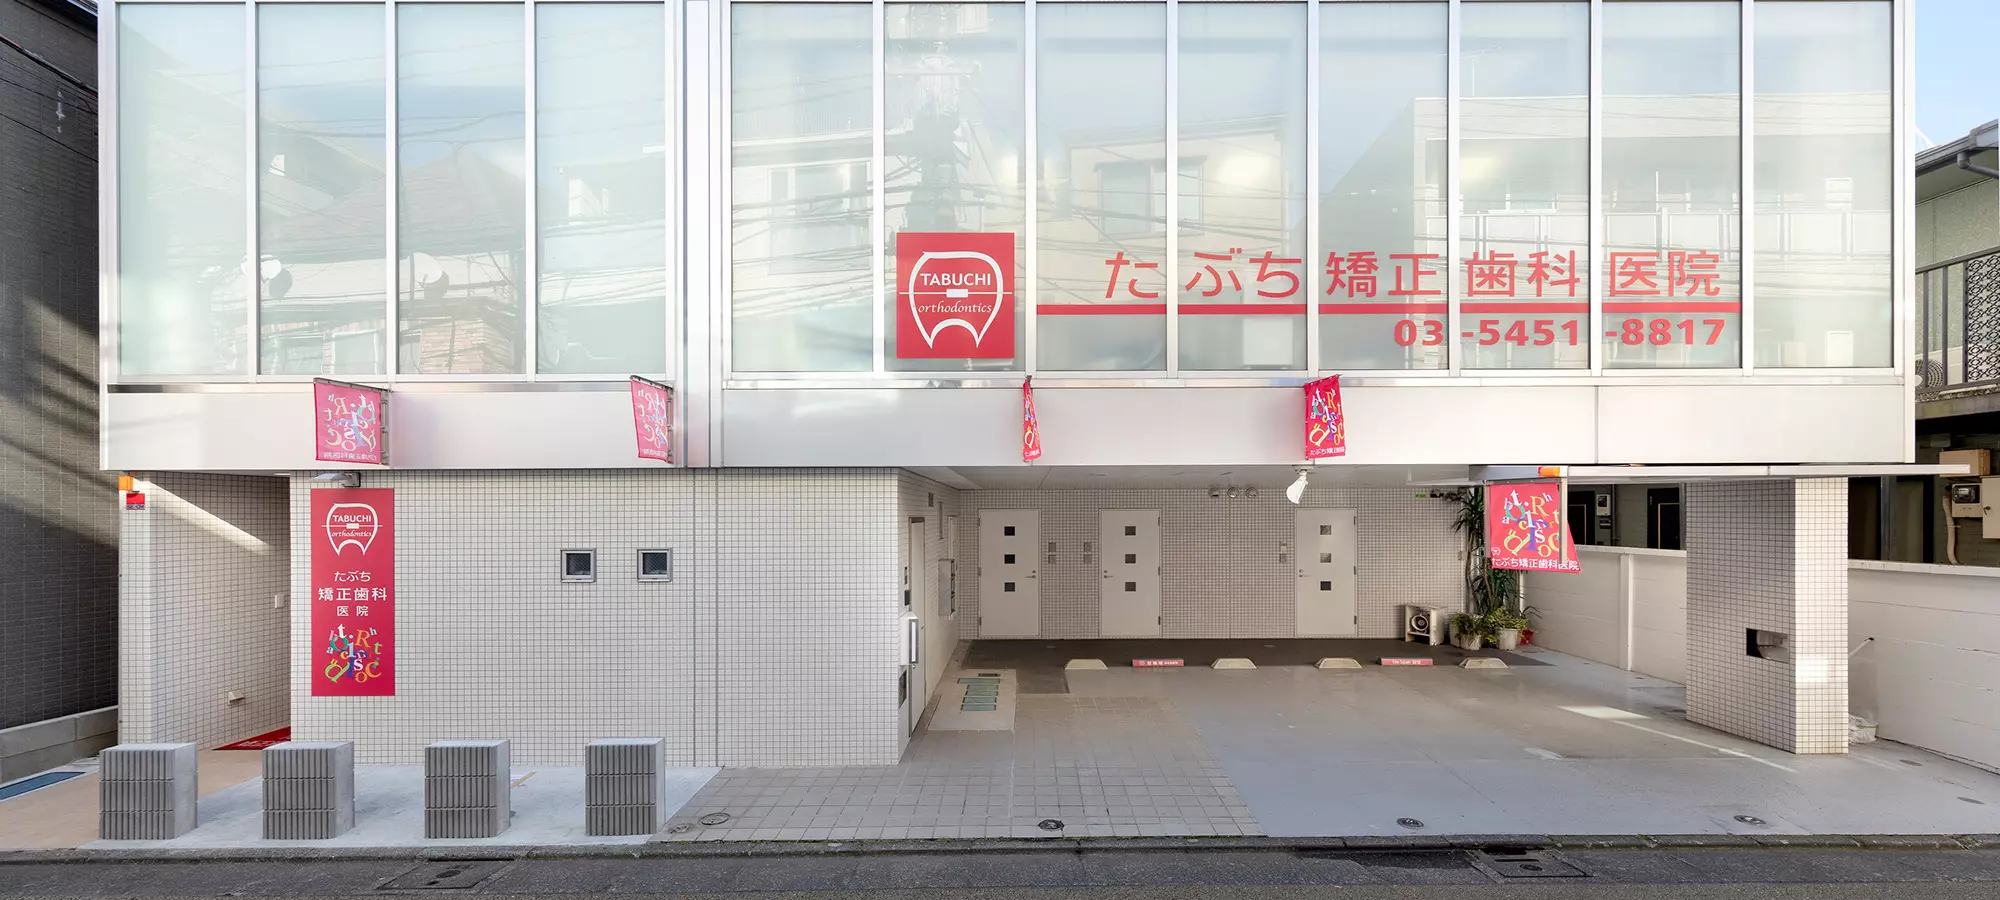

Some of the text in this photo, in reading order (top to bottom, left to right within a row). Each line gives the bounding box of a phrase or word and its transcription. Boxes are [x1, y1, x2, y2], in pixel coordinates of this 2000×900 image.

[920, 273, 991, 286] TABUCHI
[918, 300, 992, 313] orthodontics
[332, 514, 372, 523] TABUCHI
[331, 529, 373, 538] orthodontics
[334, 571, 371, 582] たぶち
[318, 587, 387, 602] 矯正歯科
